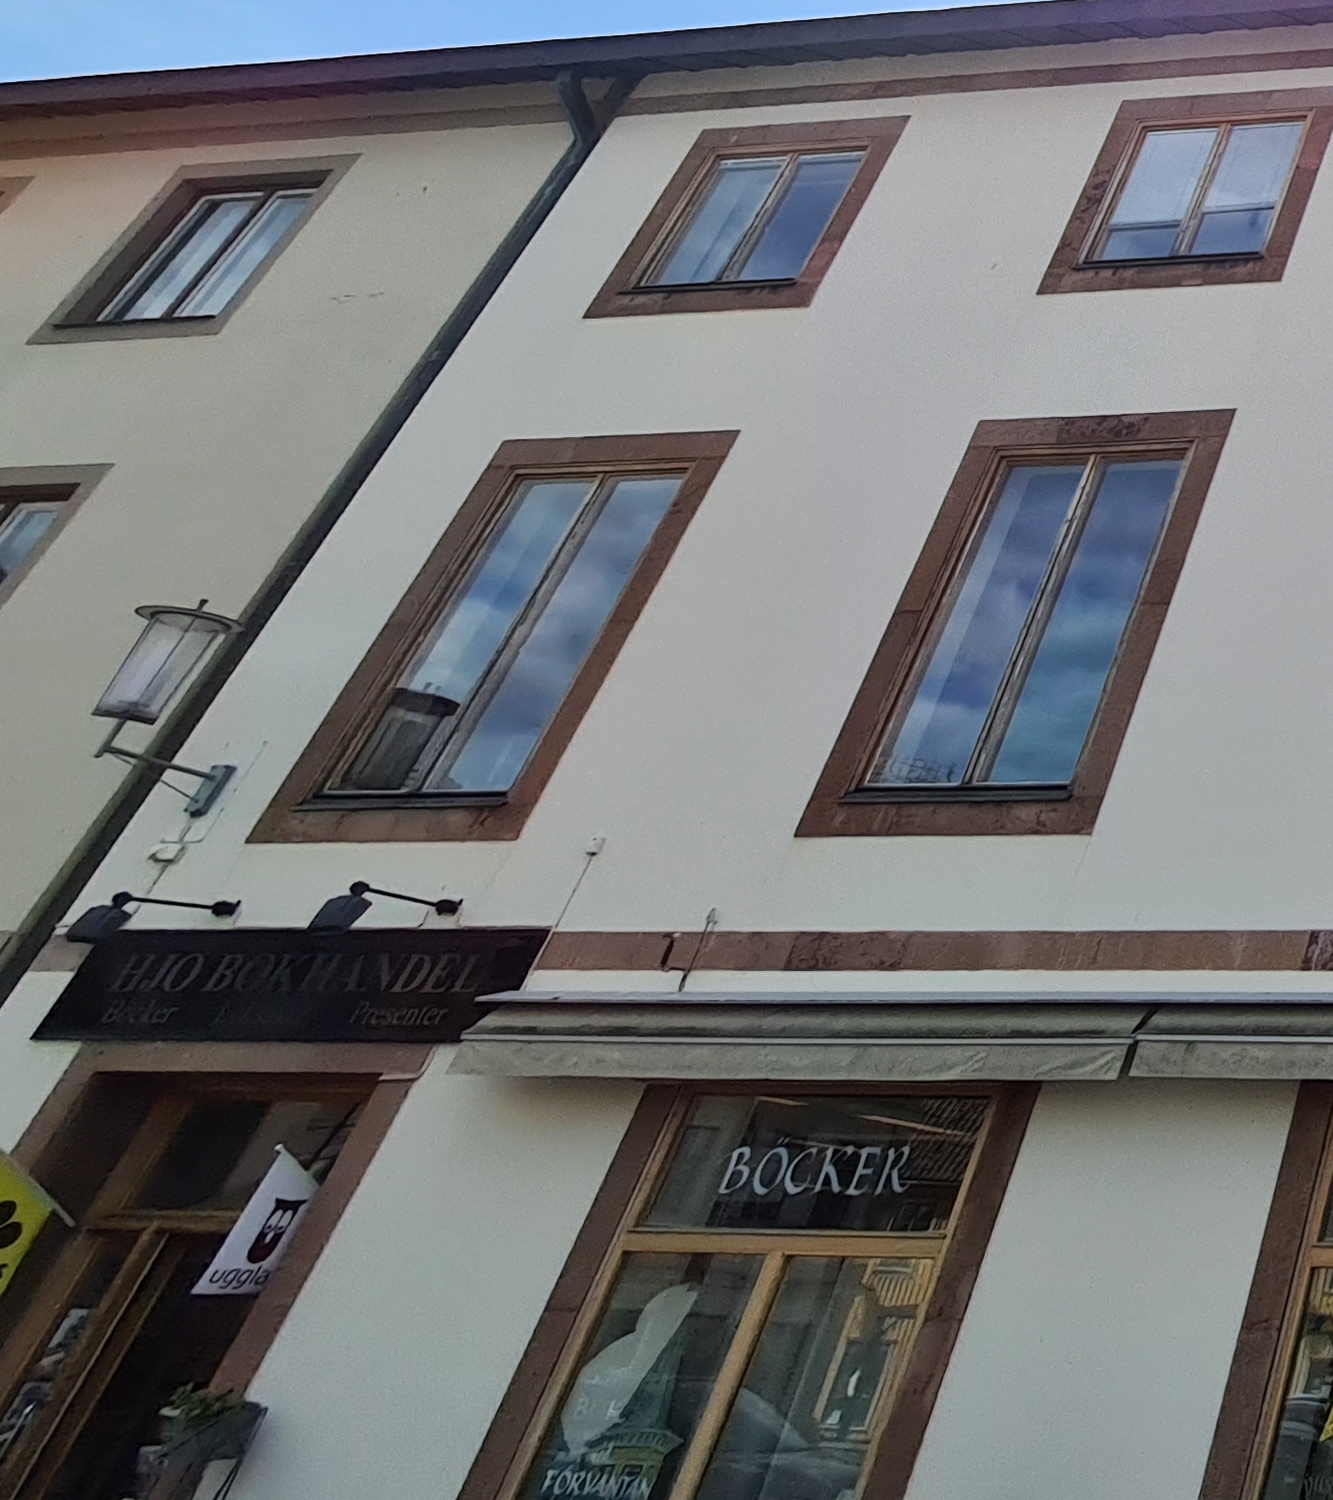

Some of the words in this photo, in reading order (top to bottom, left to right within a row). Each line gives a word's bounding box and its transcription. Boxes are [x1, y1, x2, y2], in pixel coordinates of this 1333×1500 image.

[108, 951, 207, 993] HJO
[200, 951, 482, 994] BOKHANDEL
[348, 999, 451, 1027] Presenter
[717, 1137, 912, 1197] BÖCKER
[208, 1264, 271, 1291] uggla
